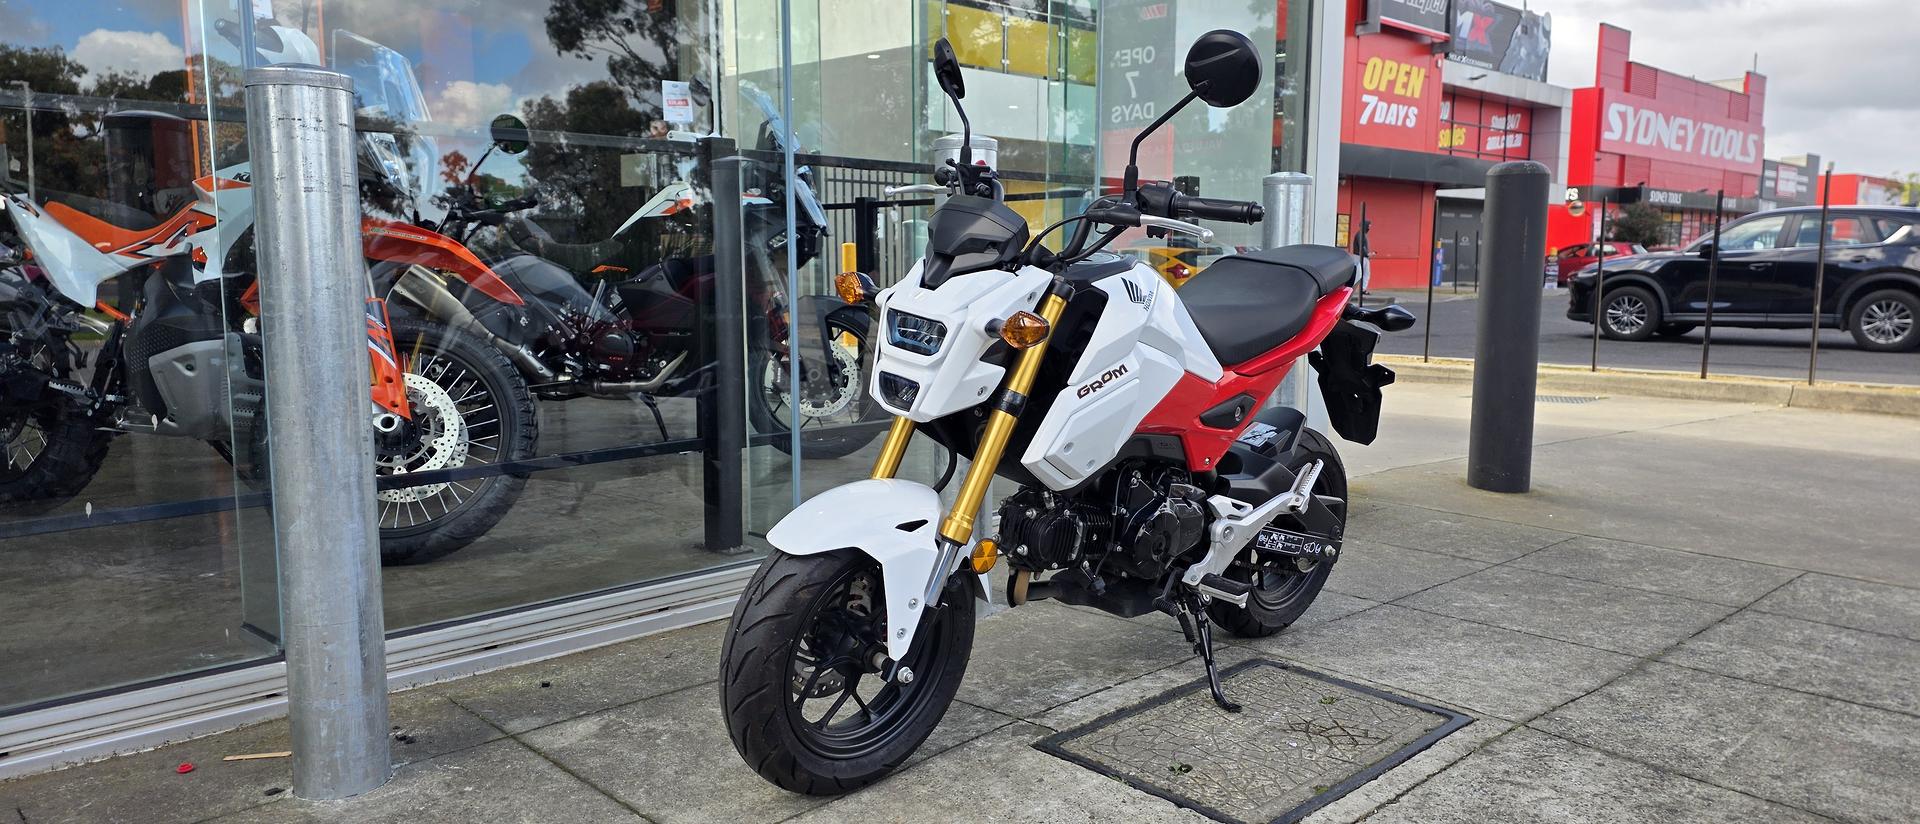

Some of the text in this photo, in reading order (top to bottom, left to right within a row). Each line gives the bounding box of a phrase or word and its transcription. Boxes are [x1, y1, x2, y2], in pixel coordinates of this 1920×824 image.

[1362, 56, 1426, 99] OPEN
[1603, 102, 1759, 164] SYDNEY TOOLS
[1076, 363, 1129, 400] GROM
